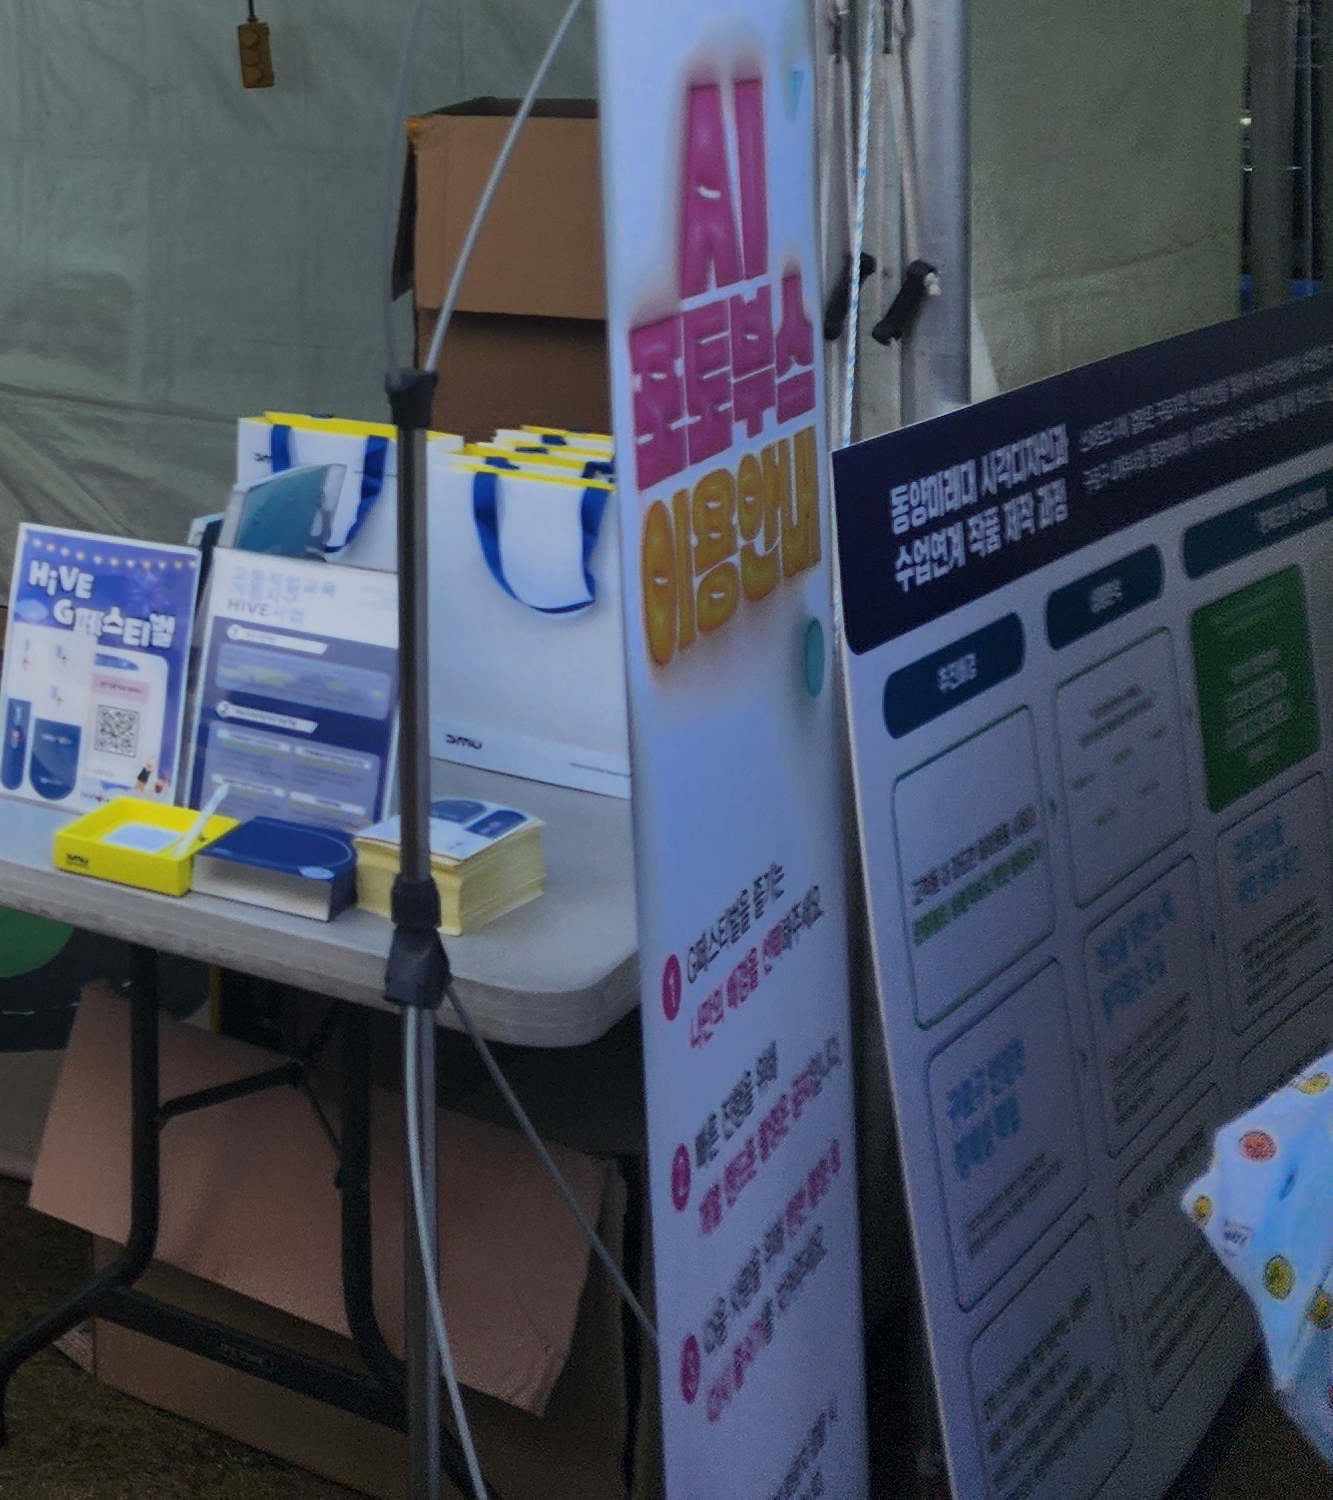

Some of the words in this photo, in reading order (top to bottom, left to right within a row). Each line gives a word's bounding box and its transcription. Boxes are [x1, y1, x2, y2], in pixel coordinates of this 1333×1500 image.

[681, 77, 769, 300] AI
[890, 459, 978, 535] 동양미래대
[981, 423, 1069, 496] 시각디자인과
[895, 522, 966, 592] 수업연계
[967, 506, 1002, 557] 작품
[1035, 478, 1068, 529] 과정
[28, 558, 94, 600] HiVE
[640, 425, 822, 667] 이용안내
[53, 598, 177, 650] G페스티벌
